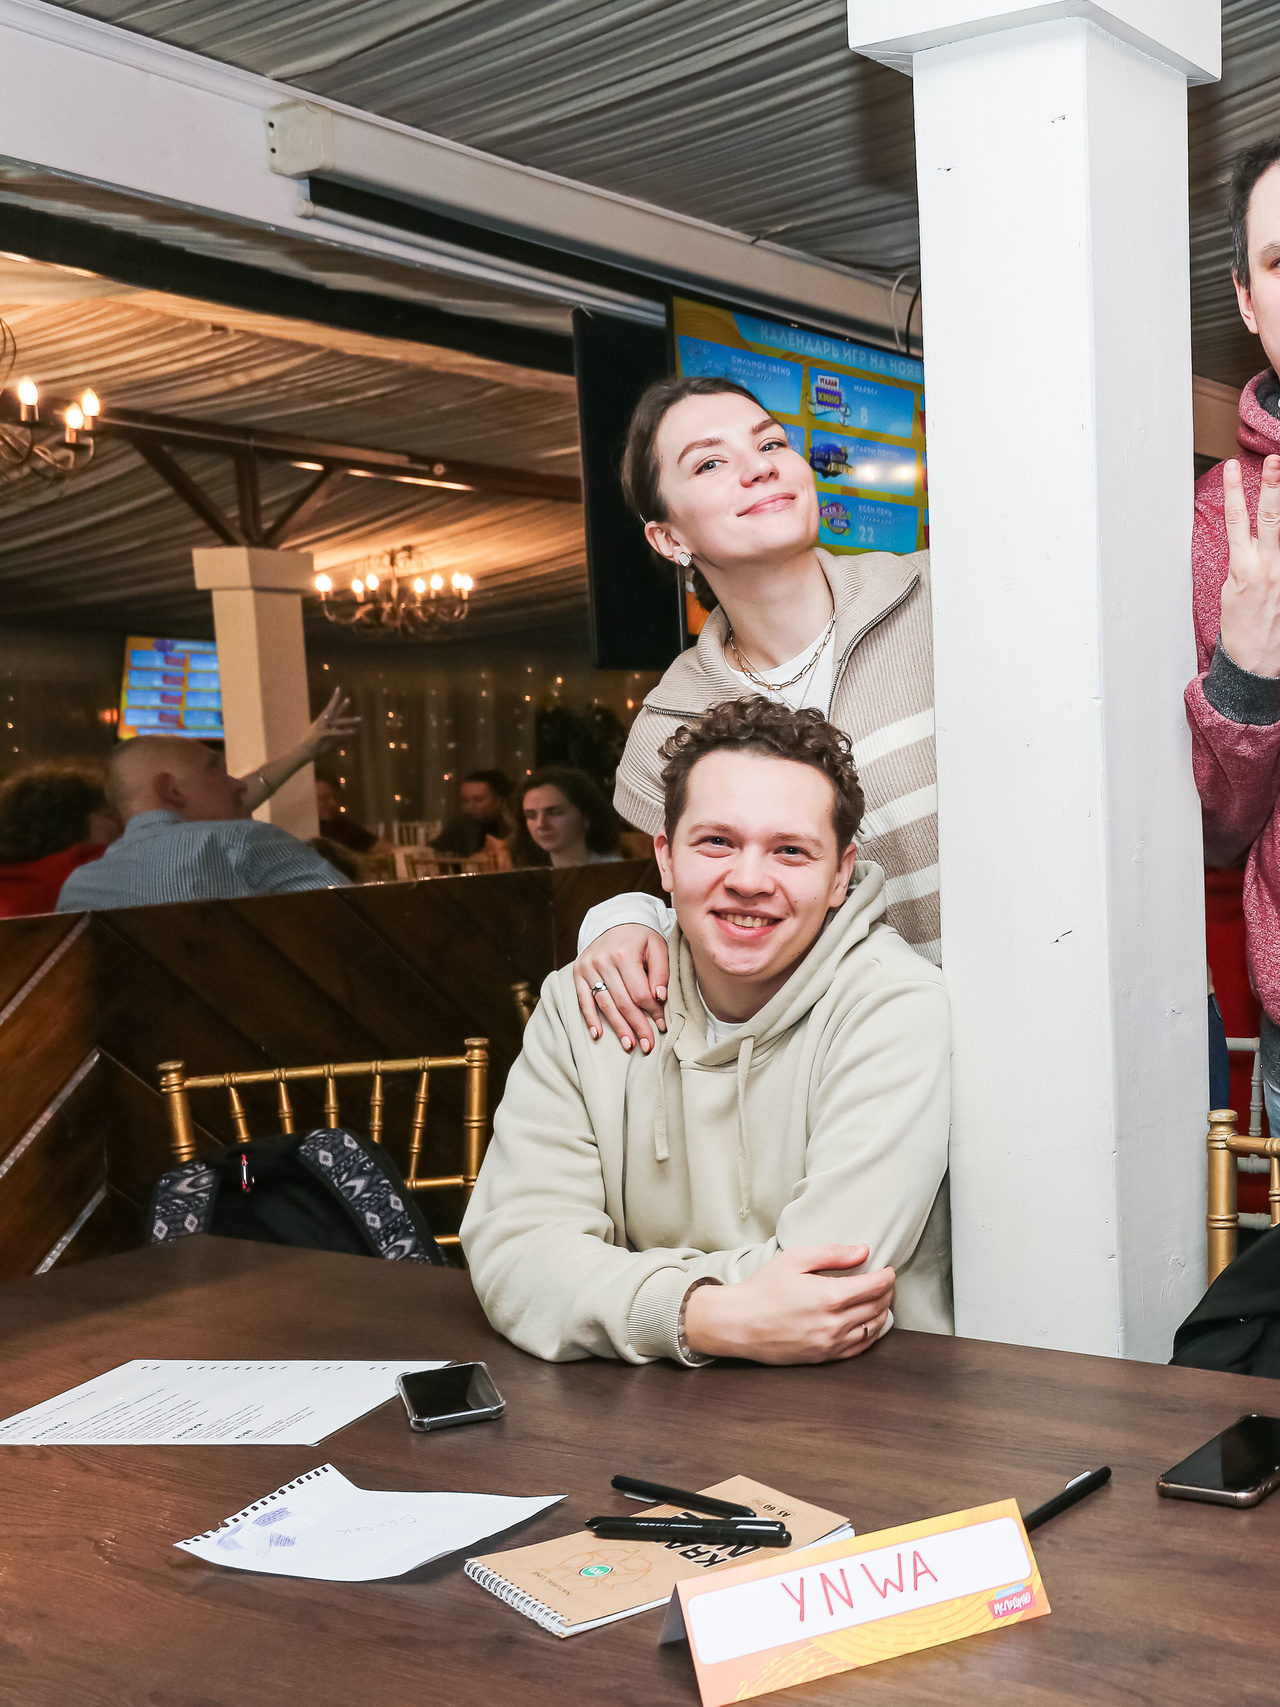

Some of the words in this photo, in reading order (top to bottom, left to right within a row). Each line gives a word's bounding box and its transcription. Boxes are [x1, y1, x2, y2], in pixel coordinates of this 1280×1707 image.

[759, 324, 840, 358] КАЛЕНДАРЬ
[843, 346, 868, 364] ИГР
[870, 354, 887, 369] НА
[858, 524, 875, 544] 22
